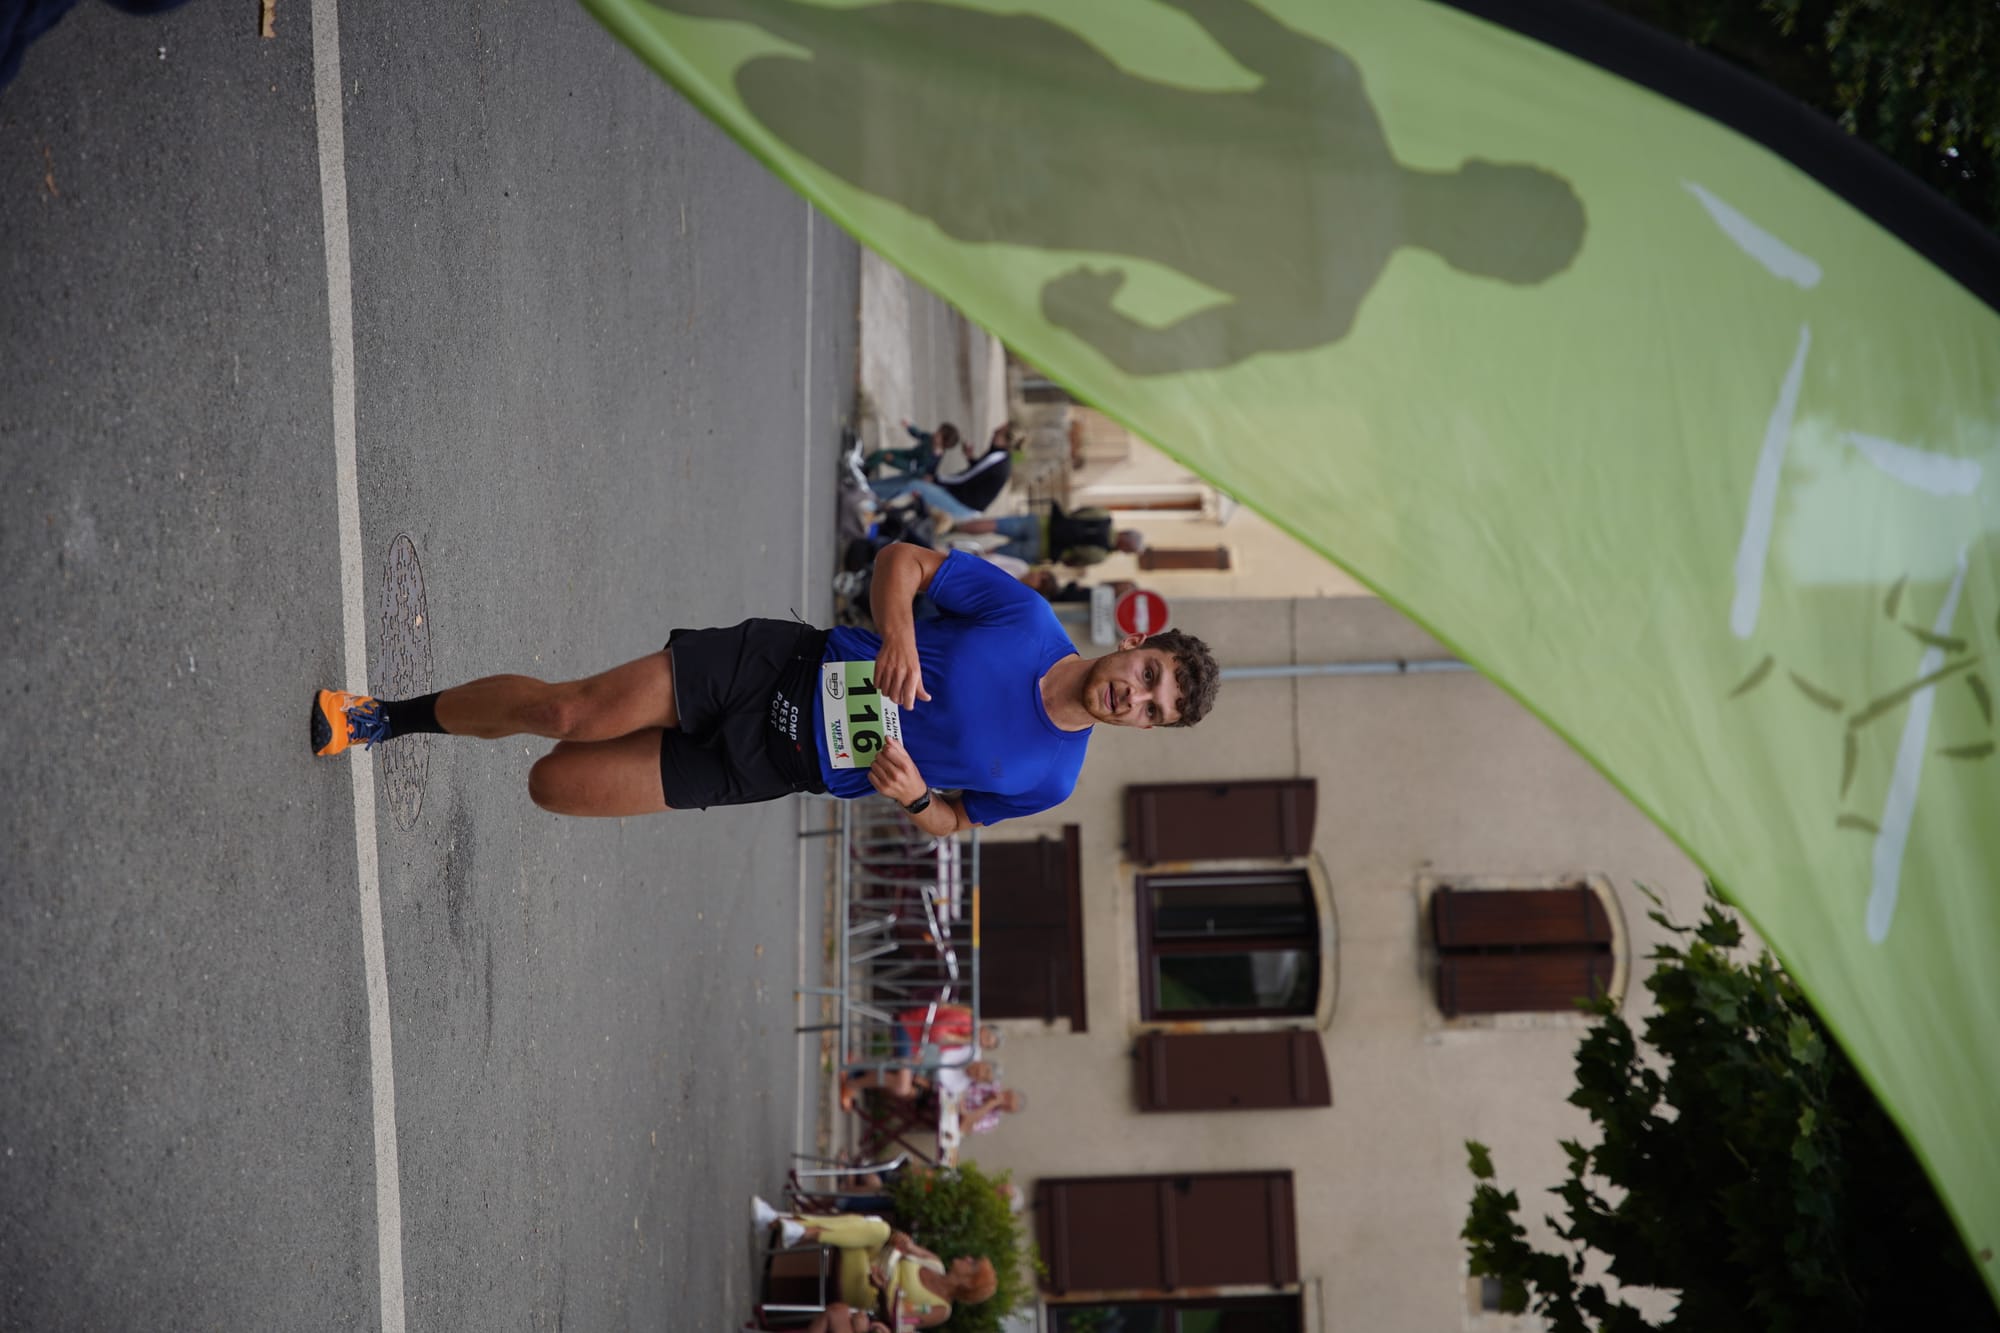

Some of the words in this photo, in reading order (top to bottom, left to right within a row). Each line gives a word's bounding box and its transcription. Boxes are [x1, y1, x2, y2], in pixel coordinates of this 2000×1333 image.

[831, 672, 839, 696] BFP
[770, 691, 783, 728] PORT
[779, 700, 790, 733] RESS
[789, 706, 799, 741] COMP
[848, 678, 882, 753] 116
